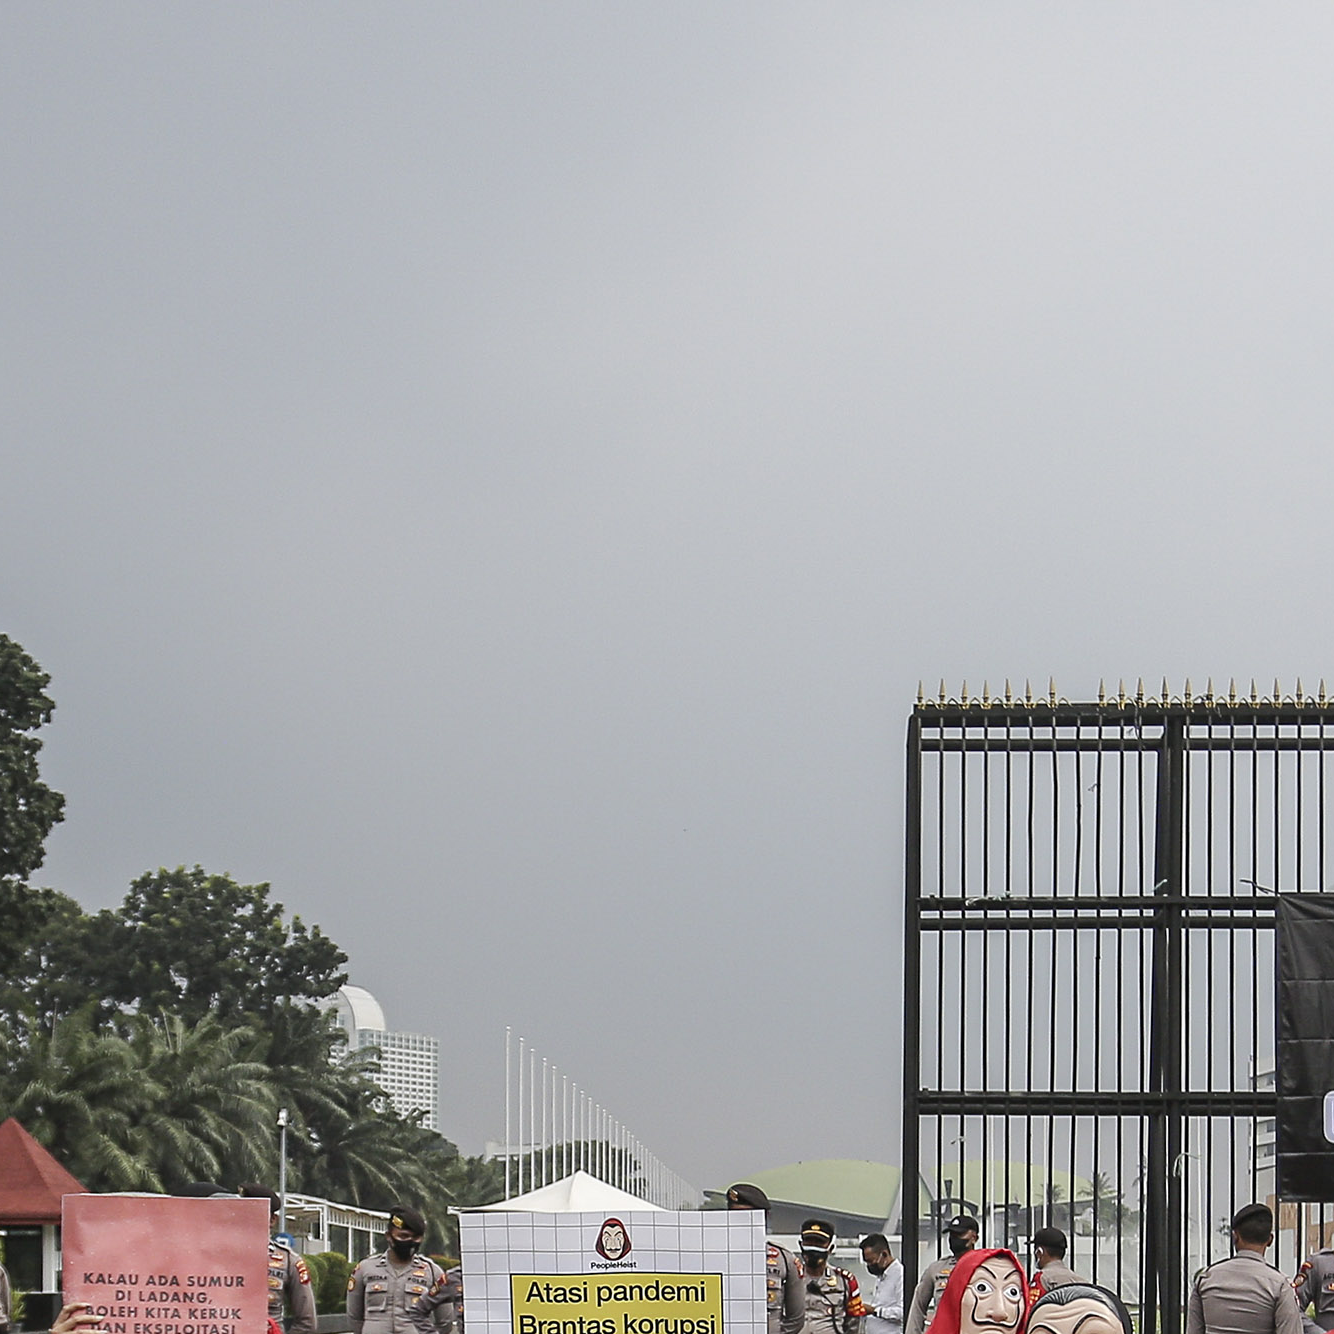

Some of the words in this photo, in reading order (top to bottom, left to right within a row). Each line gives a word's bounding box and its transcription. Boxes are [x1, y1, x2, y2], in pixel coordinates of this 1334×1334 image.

[590, 1260, 638, 1270] PeopleHeist
[83, 1272, 139, 1286] KALAU
[146, 1274, 180, 1287] ADA
[187, 1275, 245, 1288] SUMUR
[115, 1290, 132, 1302] DI
[139, 1290, 213, 1305] LADANG,
[525, 1281, 589, 1304] Atasi
[596, 1281, 707, 1307] pandemi
[85, 1305, 138, 1318] BOLEH
[145, 1306, 181, 1319] KITA
[188, 1307, 242, 1320] KERUK
